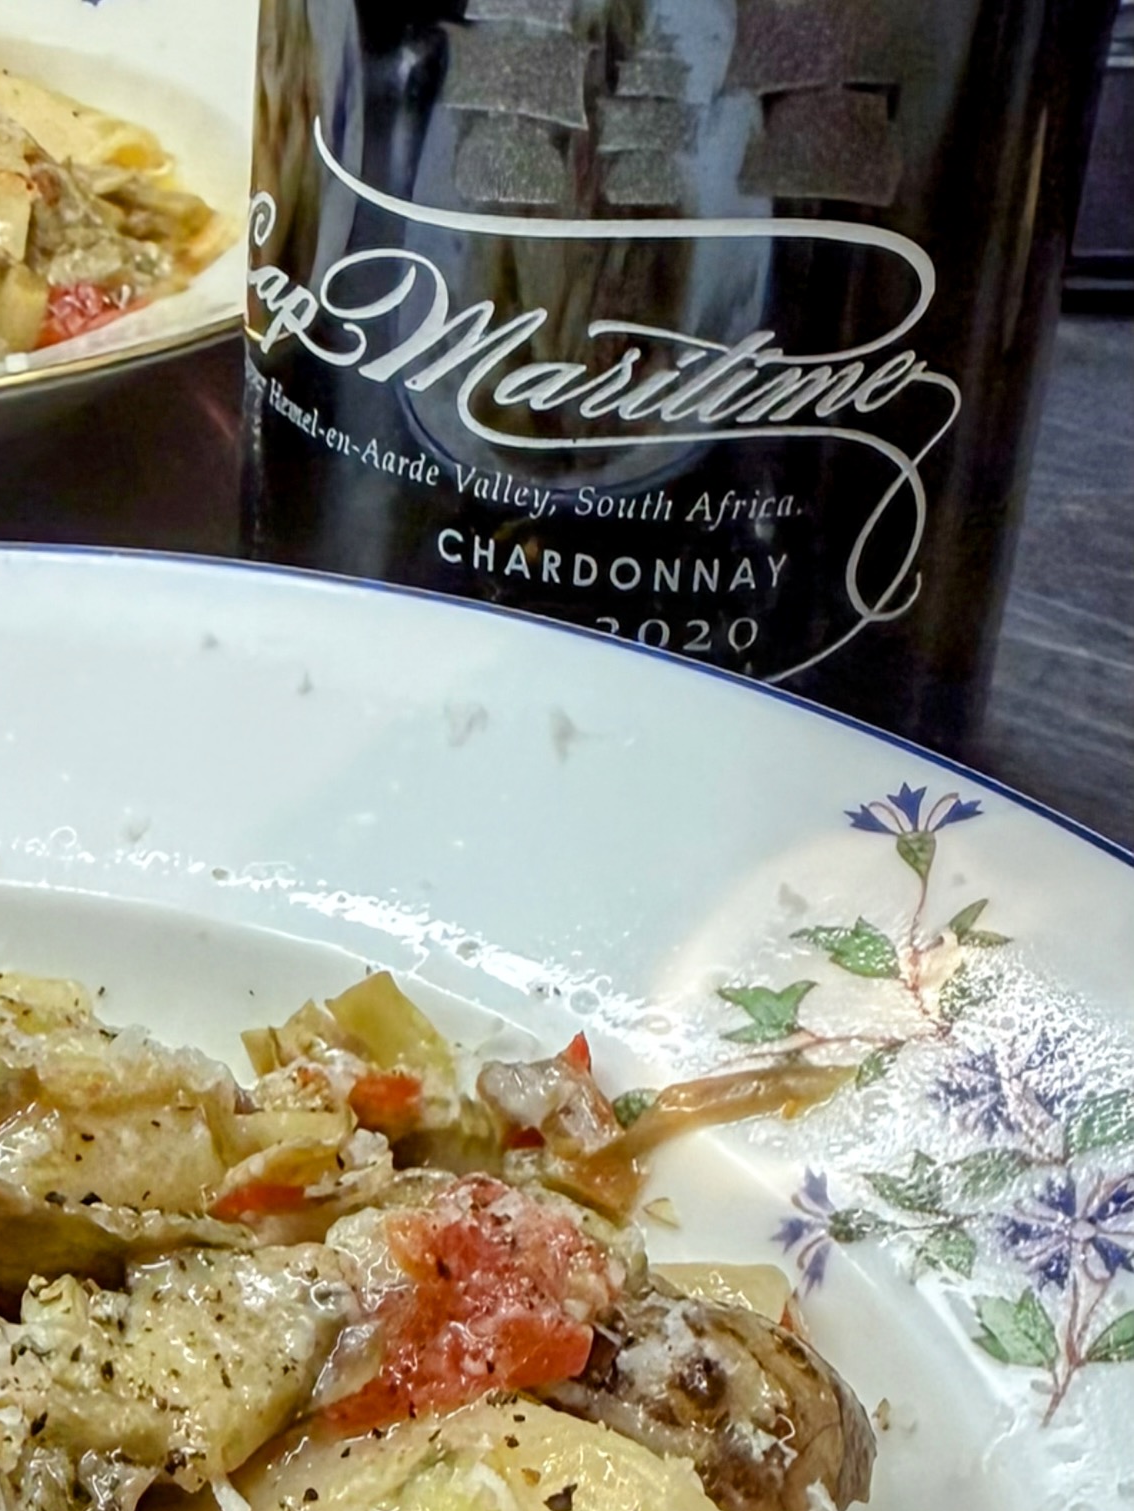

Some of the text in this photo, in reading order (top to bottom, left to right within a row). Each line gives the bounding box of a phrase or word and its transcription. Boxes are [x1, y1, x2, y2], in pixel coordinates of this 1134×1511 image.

[320, 248, 961, 450] Maritime
[269, 377, 439, 486] Hemel-en-Aarde
[455, 464, 557, 519] Valley,
[574, 486, 673, 521] South
[685, 491, 803, 531] Africa.
[437, 528, 788, 593] CHARDONNAY
